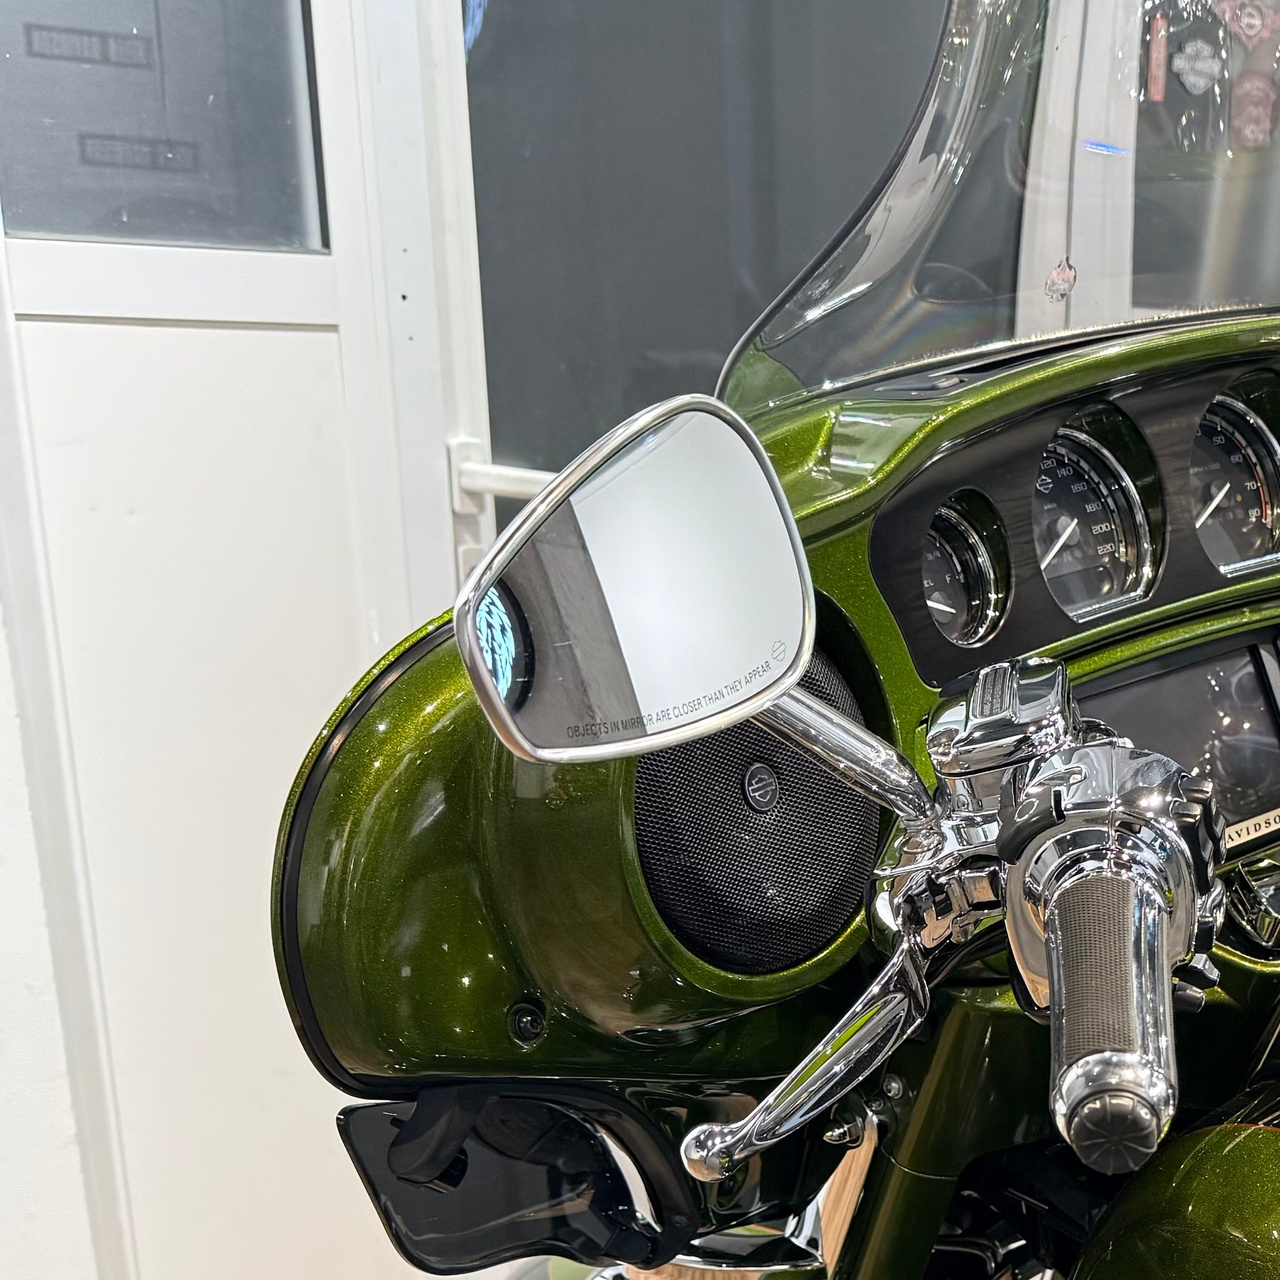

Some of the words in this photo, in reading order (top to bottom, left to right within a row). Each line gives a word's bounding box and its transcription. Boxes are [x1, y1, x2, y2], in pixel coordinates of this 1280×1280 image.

[1212, 435, 1226, 446] 50
[1040, 458, 1057, 470] 120
[1056, 467, 1074, 479] 140
[1071, 482, 1088, 494] 160
[1244, 481, 1257, 491] 70
[1085, 501, 1103, 514] 180
[1248, 508, 1261, 518] 80
[1092, 522, 1111, 535] 200
[1097, 542, 1116, 555] 220
[926, 551, 941, 561] 3/4
[923, 579, 934, 588] EL
[945, 573, 952, 583] F
[566, 722, 609, 739] OBJECTS
[609, 721, 621, 733] IN
[621, 714, 653, 731] MIRROR
[655, 709, 672, 724] ARE
[673, 698, 703, 719] CLOSER
[703, 690, 725, 706] THAN
[724, 678, 744, 696] THEY
[744, 660, 772, 685] APPEAR
